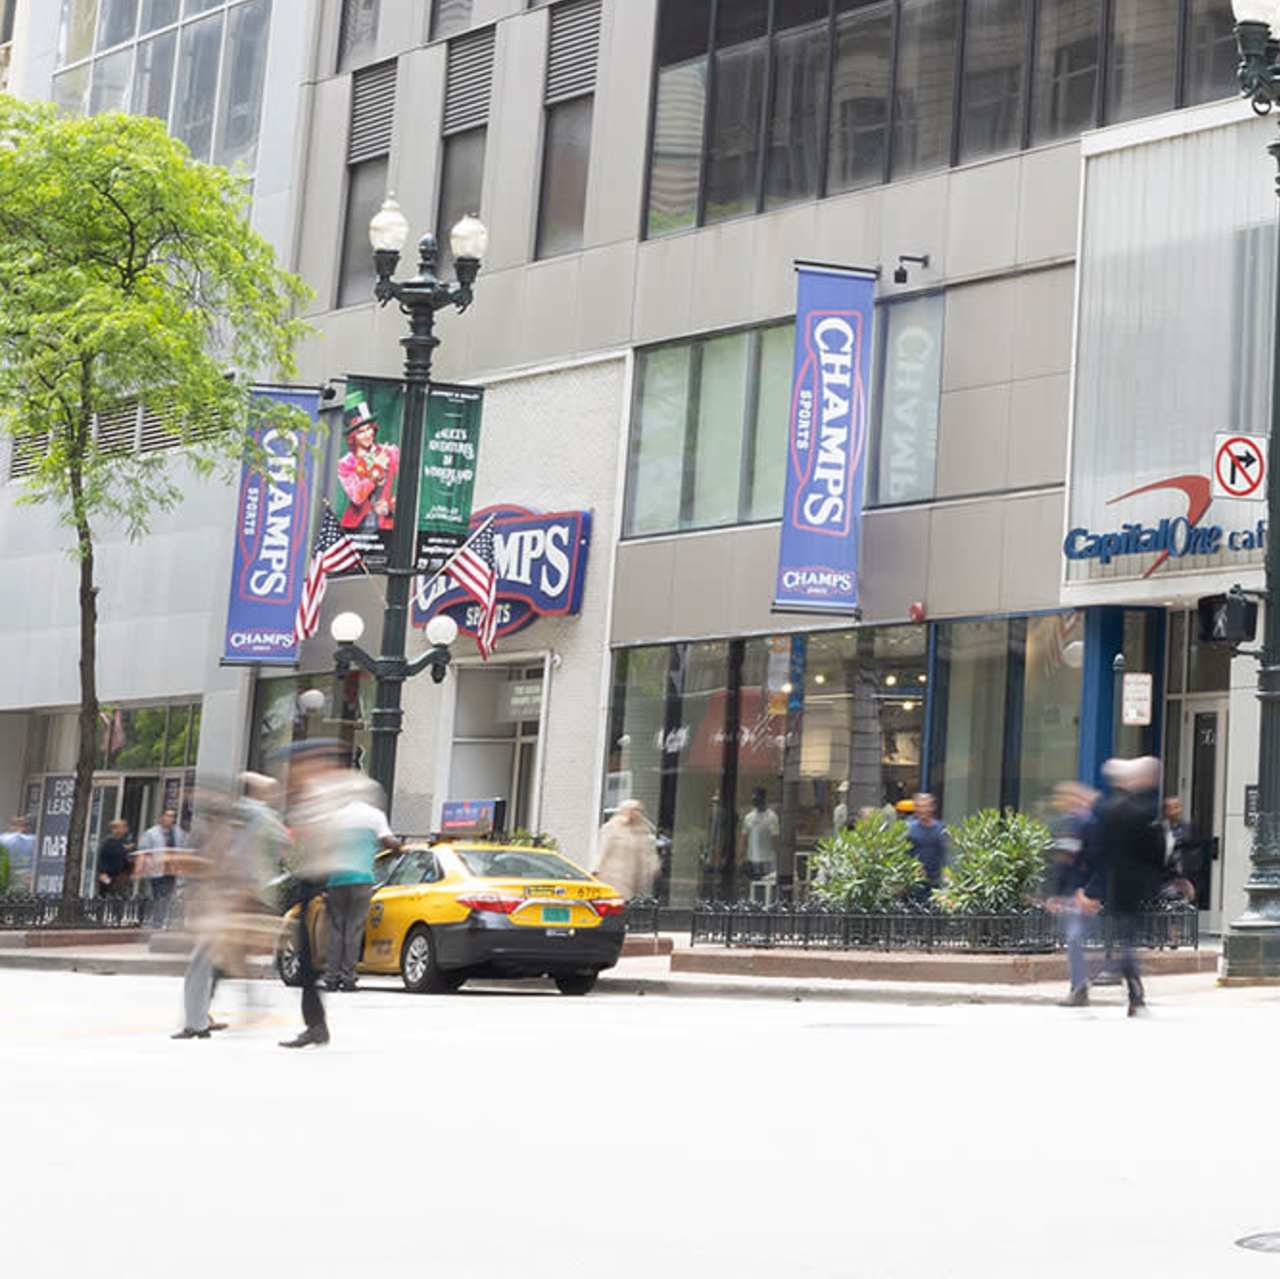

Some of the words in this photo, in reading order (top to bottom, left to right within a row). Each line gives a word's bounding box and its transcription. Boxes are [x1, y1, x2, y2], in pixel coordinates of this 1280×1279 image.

[796, 390, 813, 449] SPORTS
[804, 317, 855, 526] CHAMPS
[249, 428, 299, 596] CHAMPS
[1227, 519, 1268, 551] caf
[783, 570, 852, 592] CHAMPS
[230, 630, 297, 648] CHAMPS
[46, 798, 74, 816] LEAS
